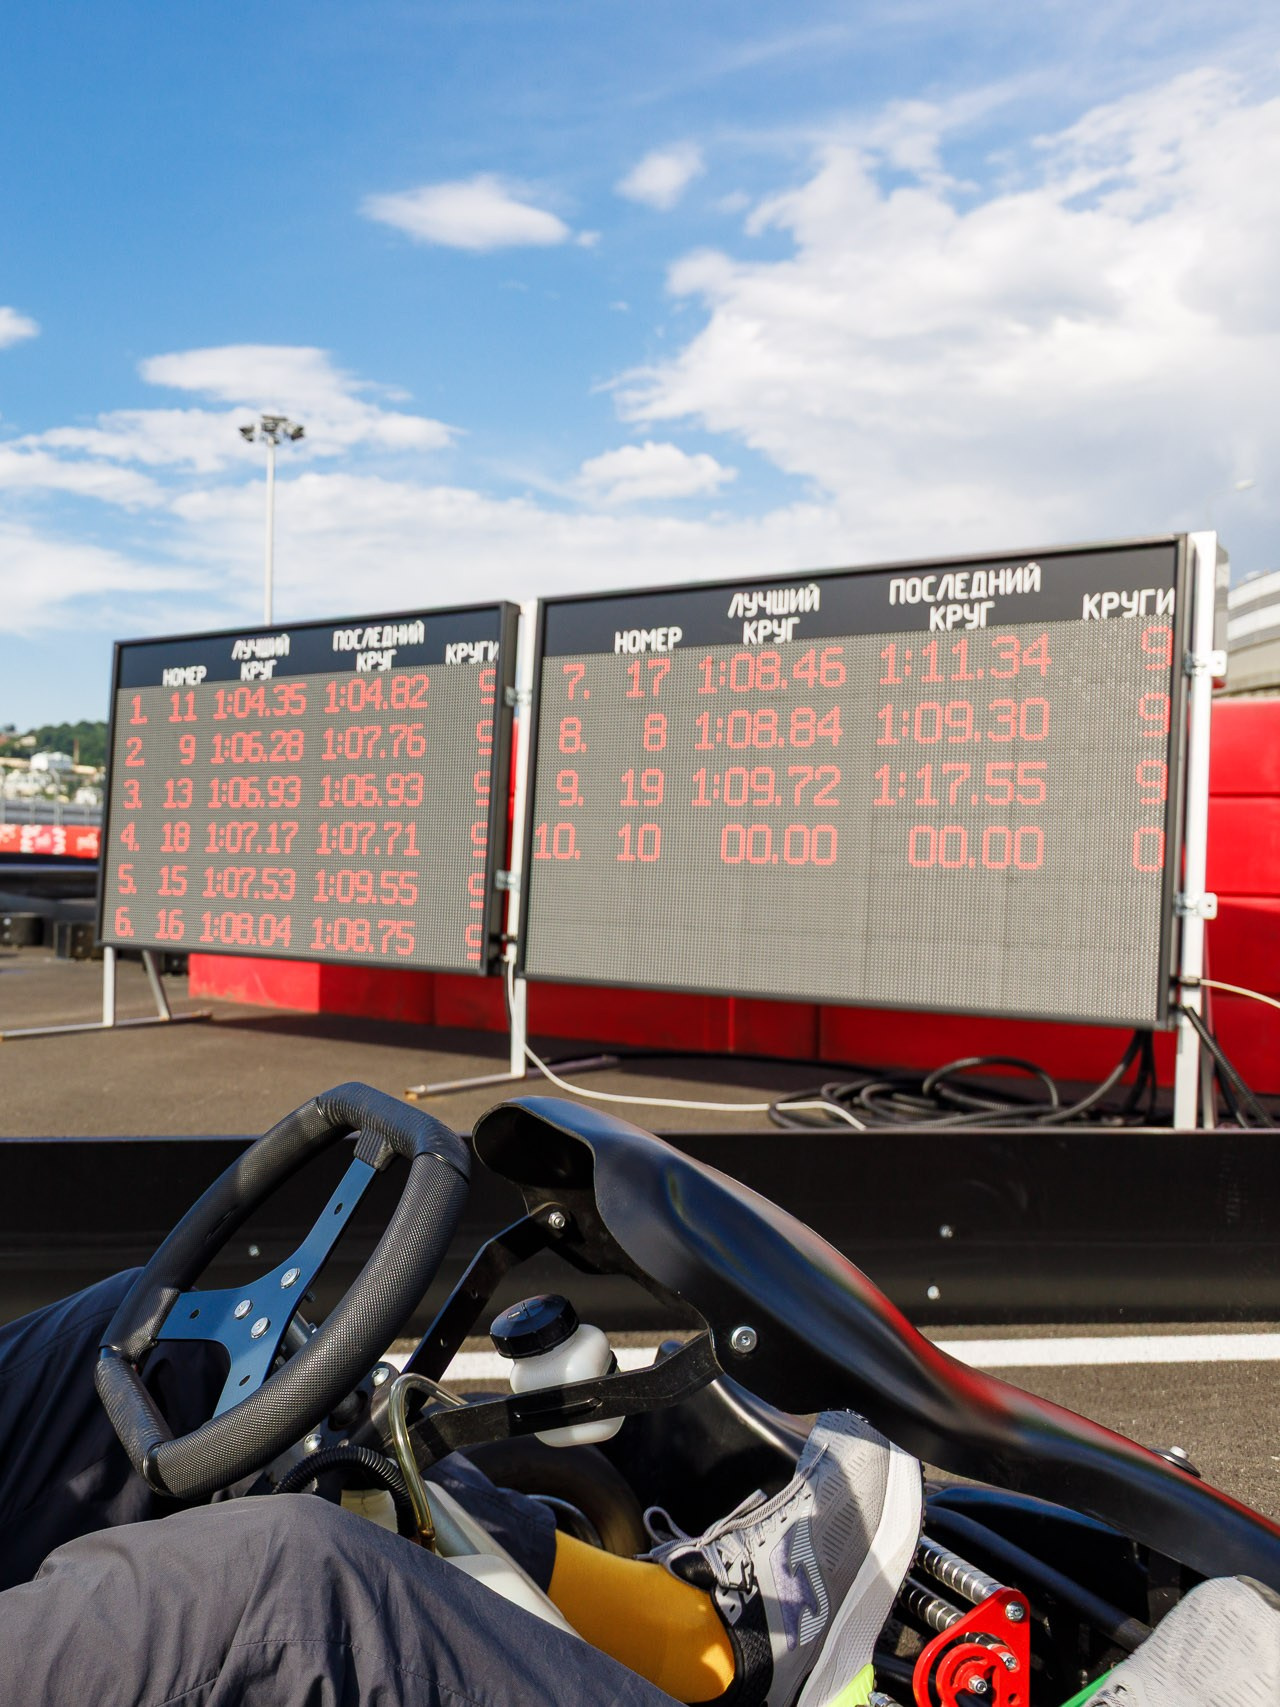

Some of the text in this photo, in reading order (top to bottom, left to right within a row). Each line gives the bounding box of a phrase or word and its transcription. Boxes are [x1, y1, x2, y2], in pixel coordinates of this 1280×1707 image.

[728, 583, 820, 618] ЛУЧШИЙ
[889, 562, 1041, 605] ПОСЛЕДНИЙ
[929, 601, 995, 632] КРУГ
[1082, 587, 1175, 620] КРУГИ
[231, 634, 290, 661] ЛУЧШИЙ
[333, 620, 425, 651] ПОСЛЕДНИЙ
[614, 626, 683, 654] НОМЕР
[742, 616, 800, 645] КРУГ
[163, 665, 207, 687] НОМЕР
[241, 659, 277, 681] КРУГ
[356, 649, 397, 672] КРУГ
[626, 658, 671, 698] 17
[698, 646, 846, 695] 1:08.46
[879, 633, 1052, 686] 1:11.34
[1141, 625, 1173, 670] 9
[169, 690, 198, 722] 11
[214, 683, 307, 720] 1:04.35
[324, 674, 429, 713] 1:04.82
[644, 713, 667, 751] 8
[695, 706, 842, 750] 1:08.84
[876, 697, 1050, 745] 1:09.30
[1138, 692, 1170, 737] 9
[179, 734, 196, 765] 9
[210, 729, 304, 763] 1:06.28
[322, 723, 426, 760] 1:07.76
[163, 778, 193, 808] 13
[208, 776, 301, 808] 1:06.93
[319, 772, 424, 807] 1:06.93
[620, 768, 664, 807] 19
[691, 765, 841, 807] 1:09.72
[874, 761, 1048, 806] 1:17.55
[1136, 759, 1168, 805] 9
[160, 821, 190, 852] 18
[204, 821, 299, 854] 1:07.17
[316, 822, 420, 856] 1:07.71
[617, 823, 661, 861] 10
[720, 824, 837, 865] 00.00
[909, 826, 1044, 870] 00.00
[1133, 827, 1165, 872] 0
[157, 865, 188, 896] 15
[202, 866, 296, 901] 1:07.53
[313, 869, 418, 906] 1:09.55
[155, 909, 184, 940] 16
[199, 911, 291, 947] 1:08.04
[310, 917, 416, 955] 1:08.75
